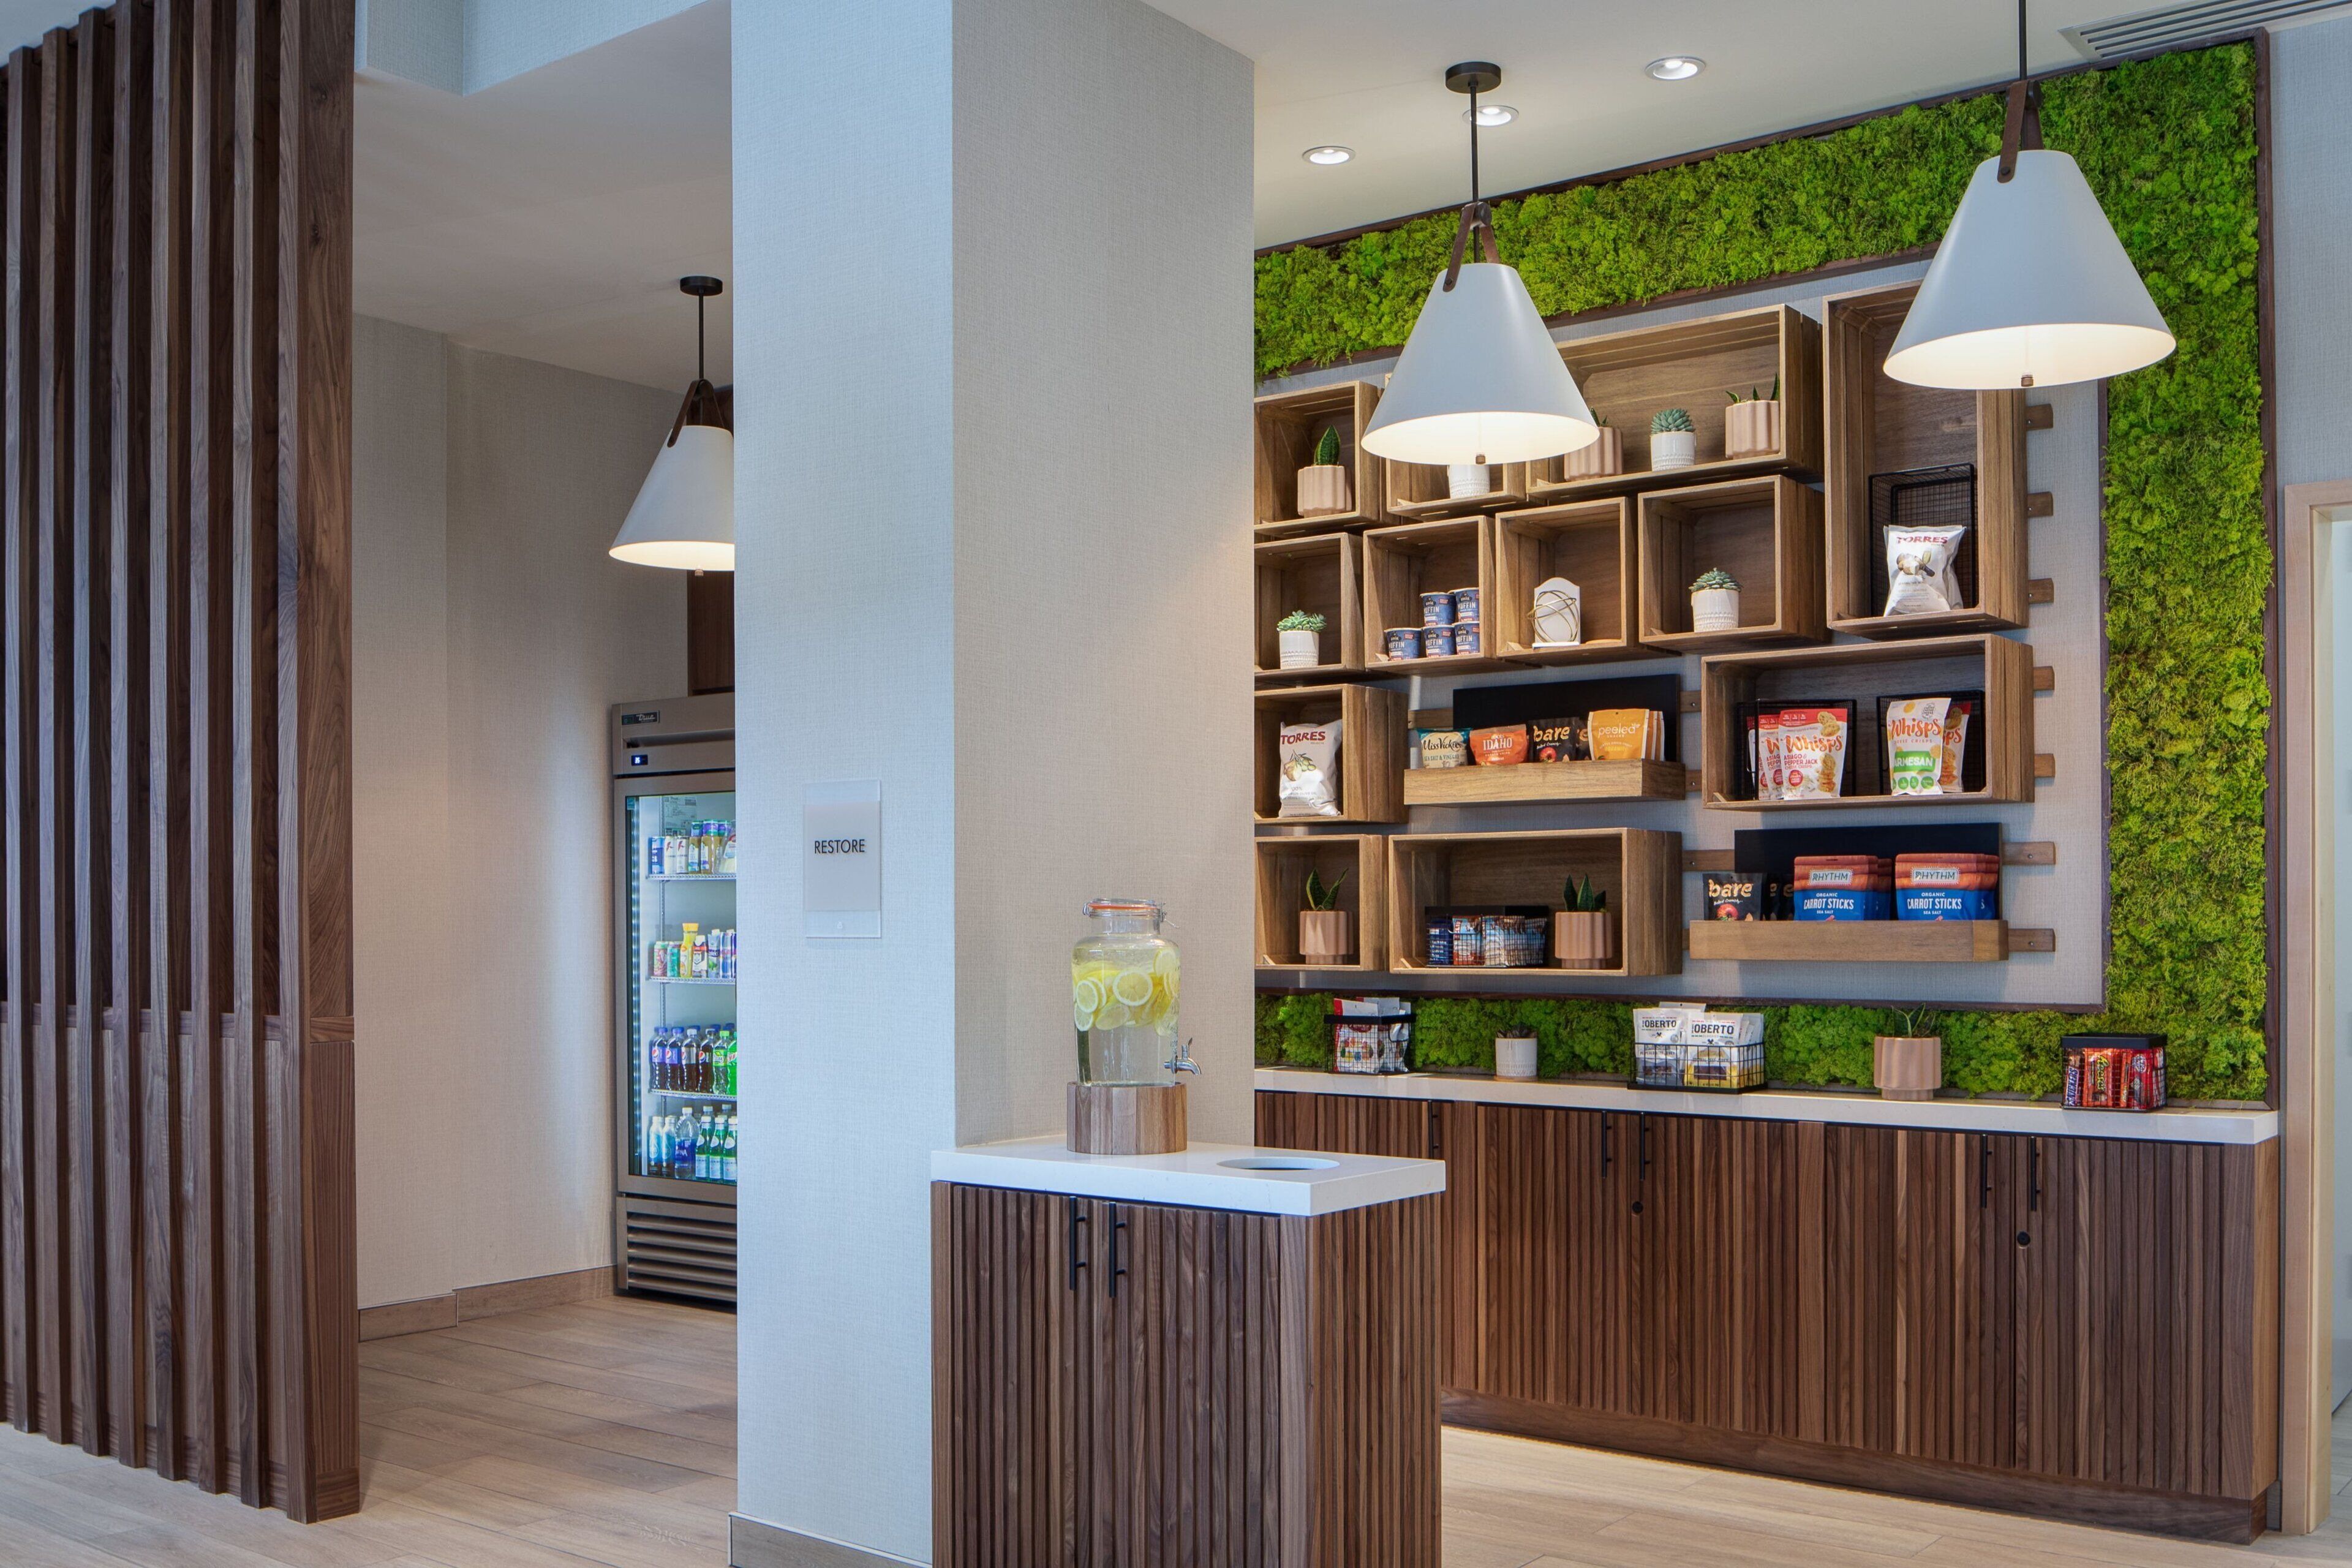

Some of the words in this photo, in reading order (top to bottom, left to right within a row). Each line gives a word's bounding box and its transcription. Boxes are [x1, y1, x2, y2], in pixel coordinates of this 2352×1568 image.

[1533, 725, 1570, 742] bare
[1597, 723, 1636, 739] peeled
[1891, 718, 1942, 739] Whisps
[1281, 731, 1325, 745] TORRES
[1483, 737, 1512, 750] IDAHO
[1785, 735, 1843, 753] Whisps
[1894, 757, 1933, 766] ARMESAN
[814, 839, 865, 854] RESTORE
[1812, 872, 1849, 881] RHYTHM
[1915, 871, 1955, 880] RHYTHM
[1708, 879, 1752, 897] bare
[1804, 899, 1827, 910] CARROT
[1828, 899, 1854, 910] STICKS
[1907, 899, 1934, 909] CARROT
[1935, 899, 1962, 909] STICKS
[1694, 1024, 1734, 1035] OBERTO
